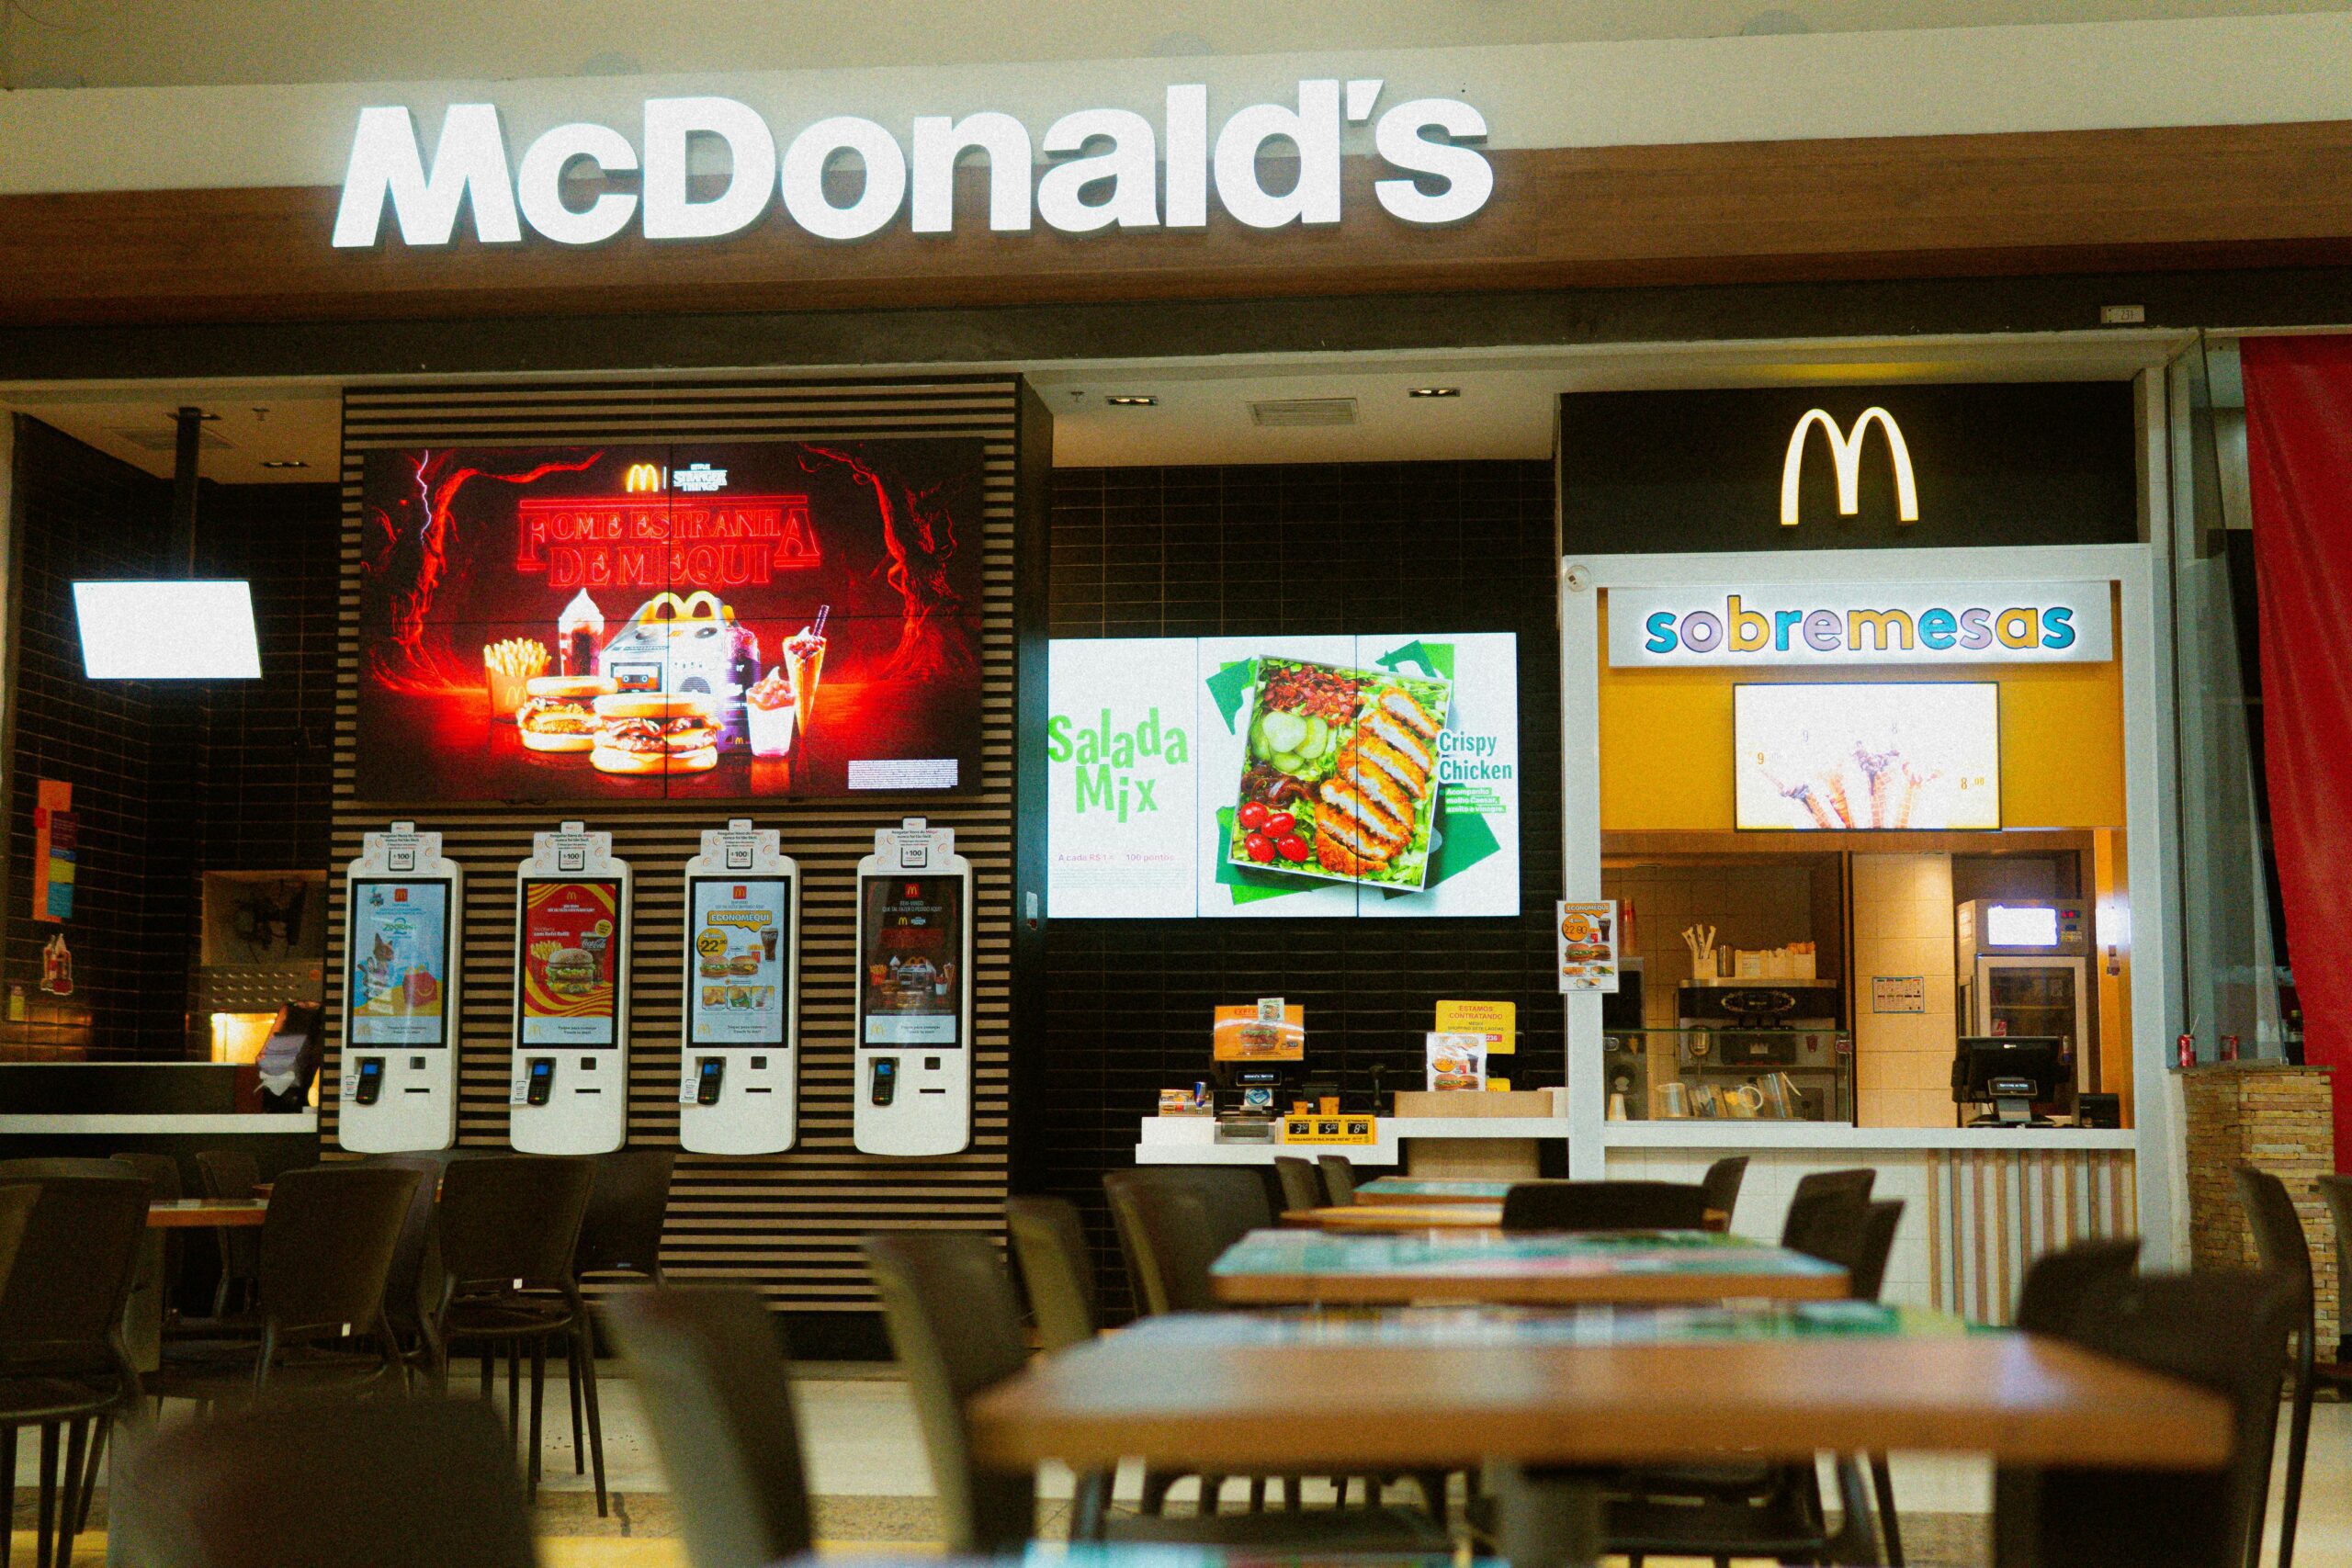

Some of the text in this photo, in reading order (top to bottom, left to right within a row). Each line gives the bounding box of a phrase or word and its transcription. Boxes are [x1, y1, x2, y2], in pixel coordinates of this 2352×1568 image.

[332, 79, 1494, 248] McDonald's
[518, 508, 820, 561] FOME ESTRANHA
[548, 546, 611, 587] DE
[1645, 594, 2075, 653] sobremesas
[1048, 706, 1189, 770] Salada
[1439, 730, 1498, 757] Crispy
[1075, 763, 1159, 824] Mix
[1439, 760, 1513, 781] Chicken
[1126, 853, 1142, 862] 100
